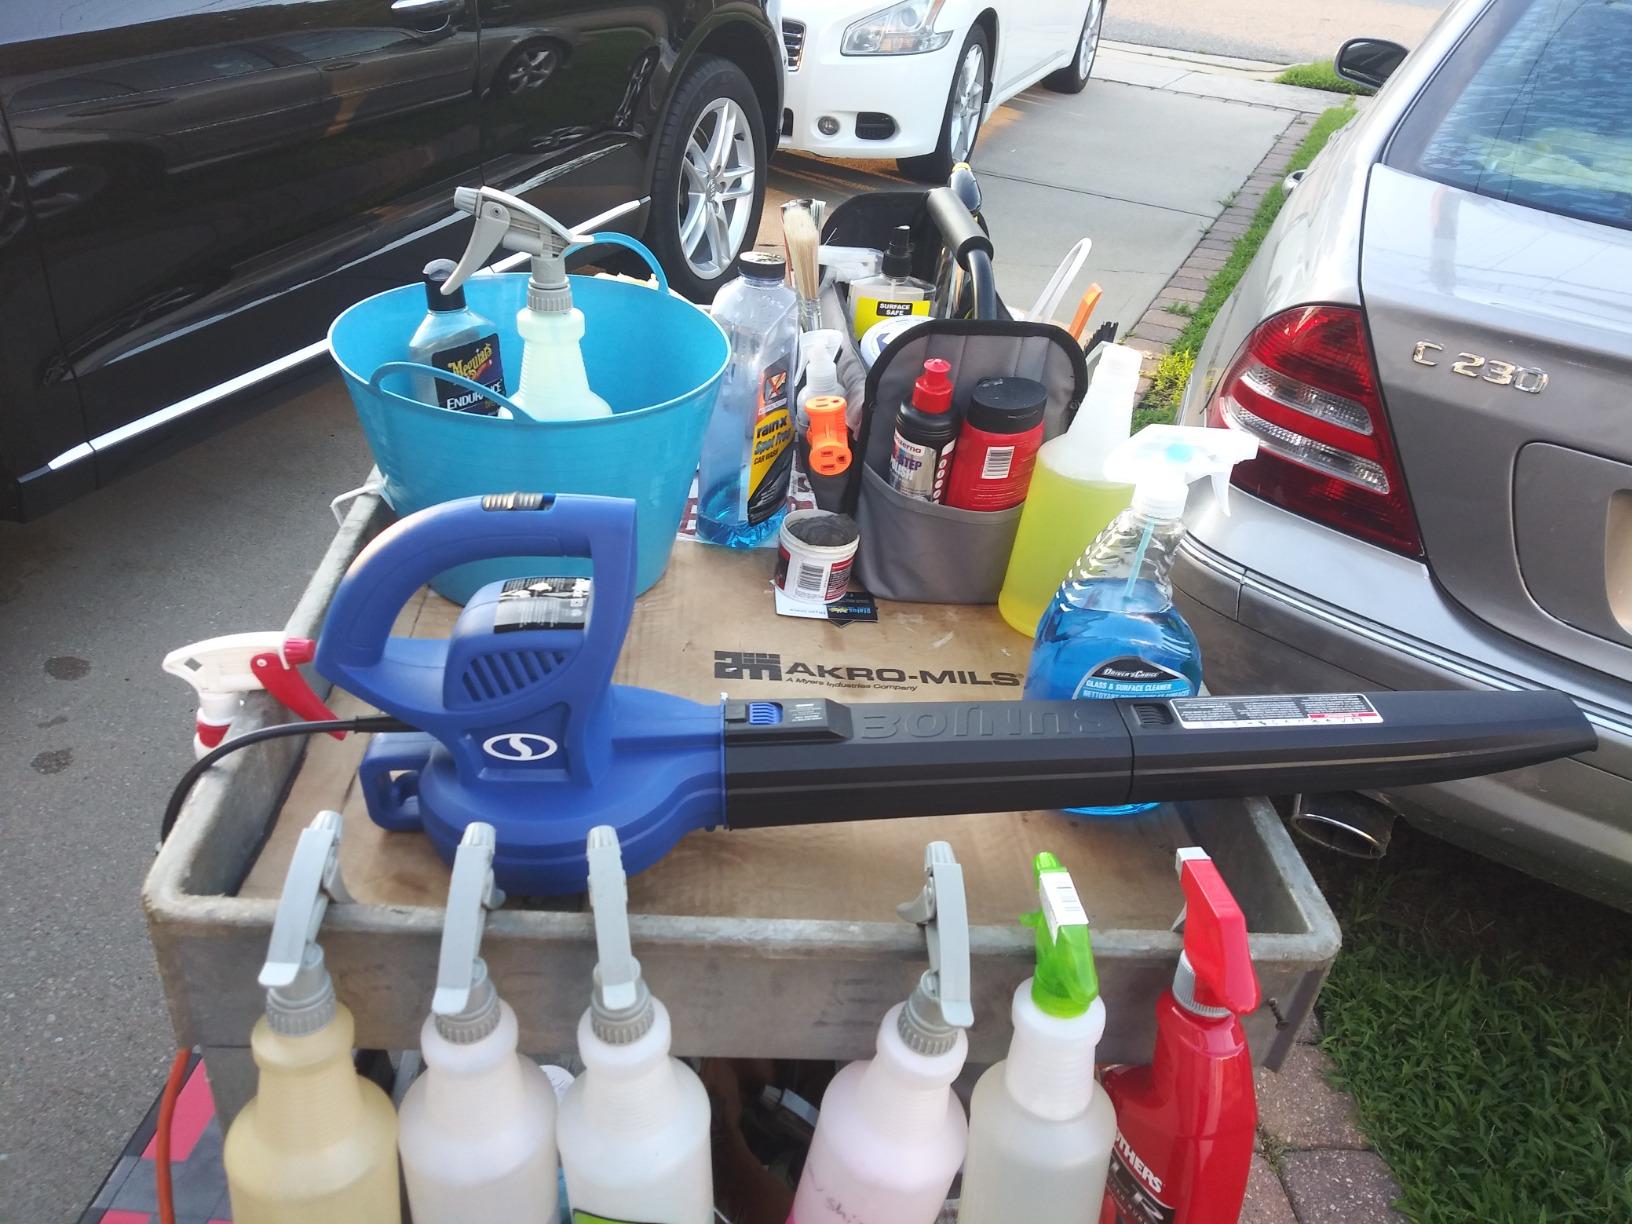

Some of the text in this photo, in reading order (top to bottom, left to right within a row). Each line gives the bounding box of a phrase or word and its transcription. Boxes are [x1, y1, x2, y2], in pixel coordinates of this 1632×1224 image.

[1413, 340, 1549, 394] C 230
[446, 381, 502, 410] ENDURCE
[796, 678, 824, 686] Myers
[873, 683, 918, 691] Company
[1086, 680, 1107, 690] GLASS
[1115, 683, 1144, 691] SURFACE
[1144, 683, 1172, 691] CLEANER
[1117, 1131, 1164, 1194] THERS
